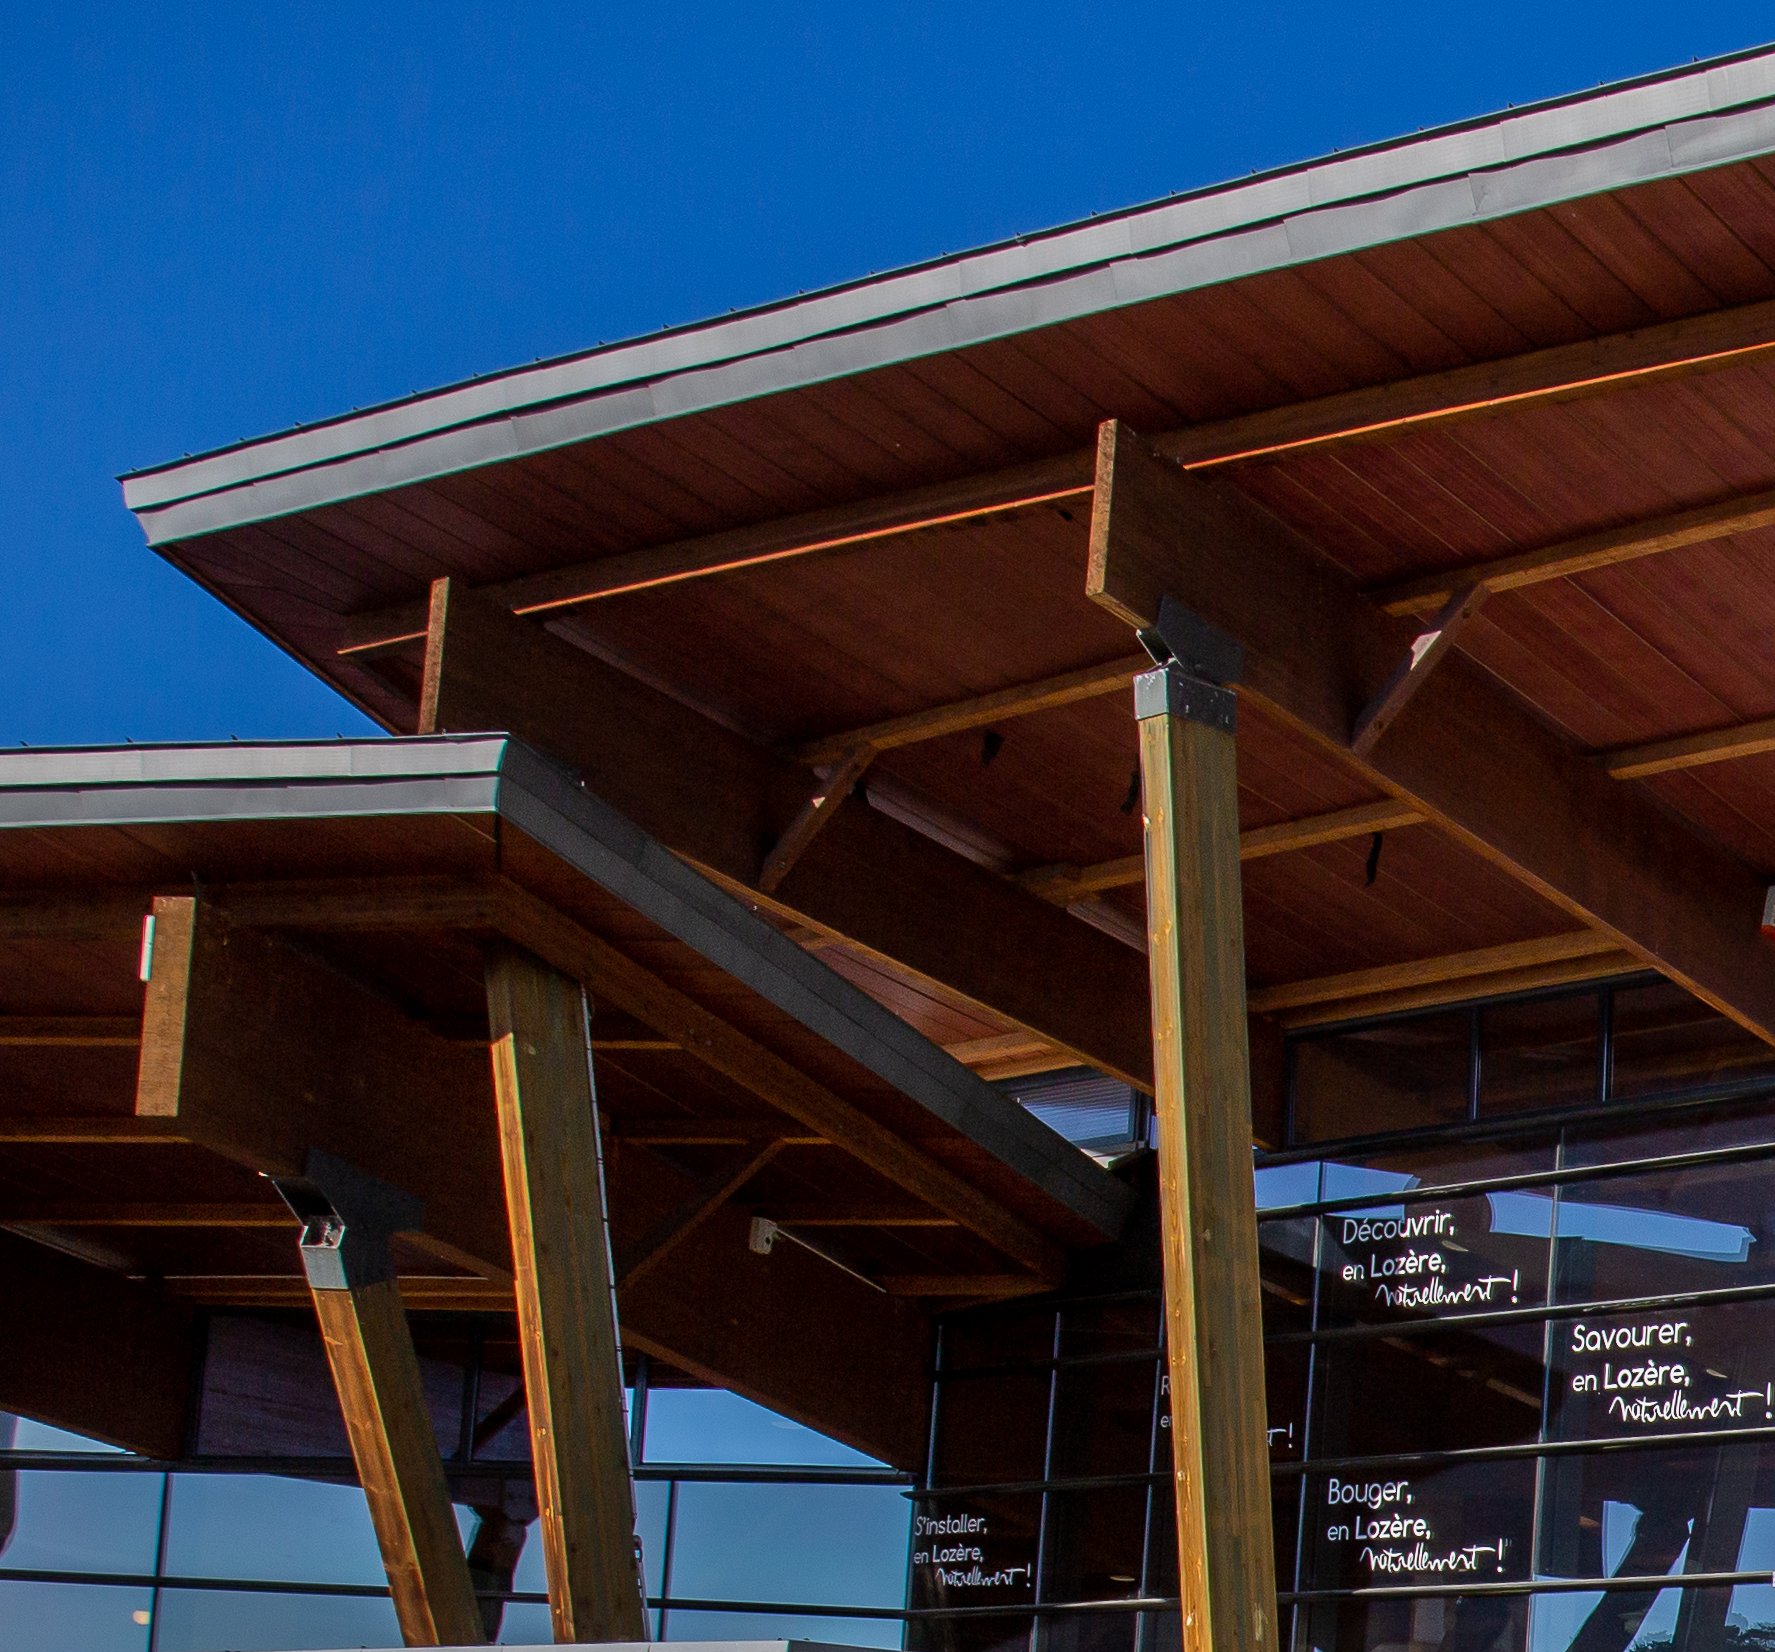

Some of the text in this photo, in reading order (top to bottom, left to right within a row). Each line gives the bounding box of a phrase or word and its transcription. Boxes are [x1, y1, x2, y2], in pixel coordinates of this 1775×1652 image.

[1342, 1209, 1455, 1245] Découvrir,
[1342, 1249, 1447, 1281] en Lozère,
[1571, 1322, 1692, 1351] Savourer,
[1572, 1359, 1690, 1392] en Lozère,
[1327, 1478, 1413, 1510] Bouger,
[914, 1513, 988, 1536] S'installer,
[1327, 1513, 1432, 1541] en Lozère,
[913, 1543, 984, 1564] en Lozère,
